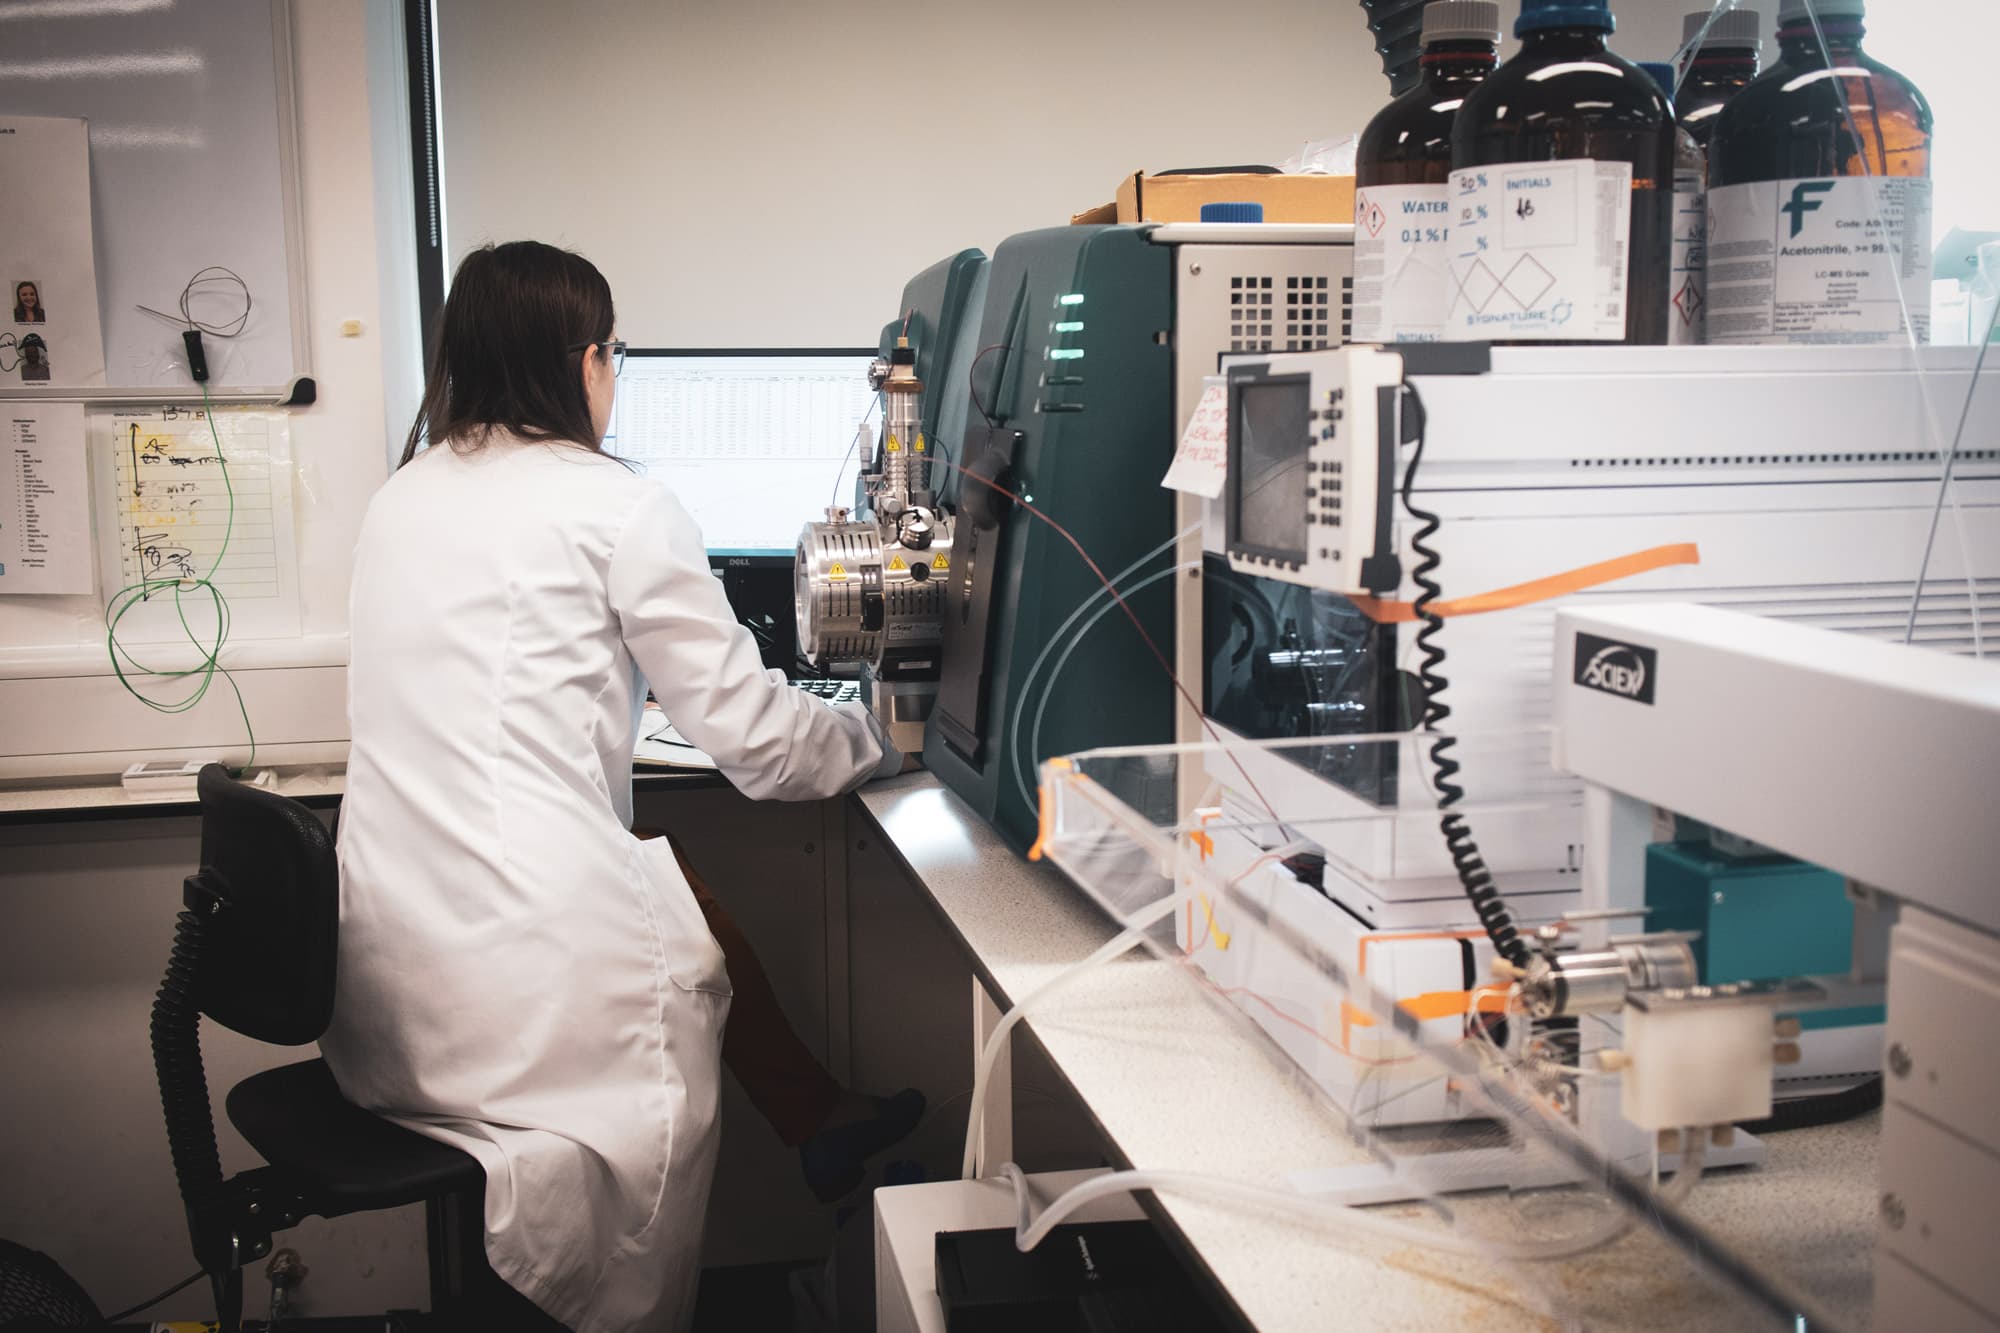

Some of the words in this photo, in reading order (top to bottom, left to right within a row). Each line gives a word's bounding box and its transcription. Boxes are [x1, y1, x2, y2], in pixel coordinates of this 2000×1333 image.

[1506, 177, 1551, 191] INITIALS
[1402, 200, 1448, 213] WATER
[1780, 181, 1836, 240] F
[1401, 229, 1421, 242] 0.1
[1425, 229, 1440, 241] %
[1780, 243, 1851, 257] Acetonitrile,
[729, 558, 751, 566] DELL
